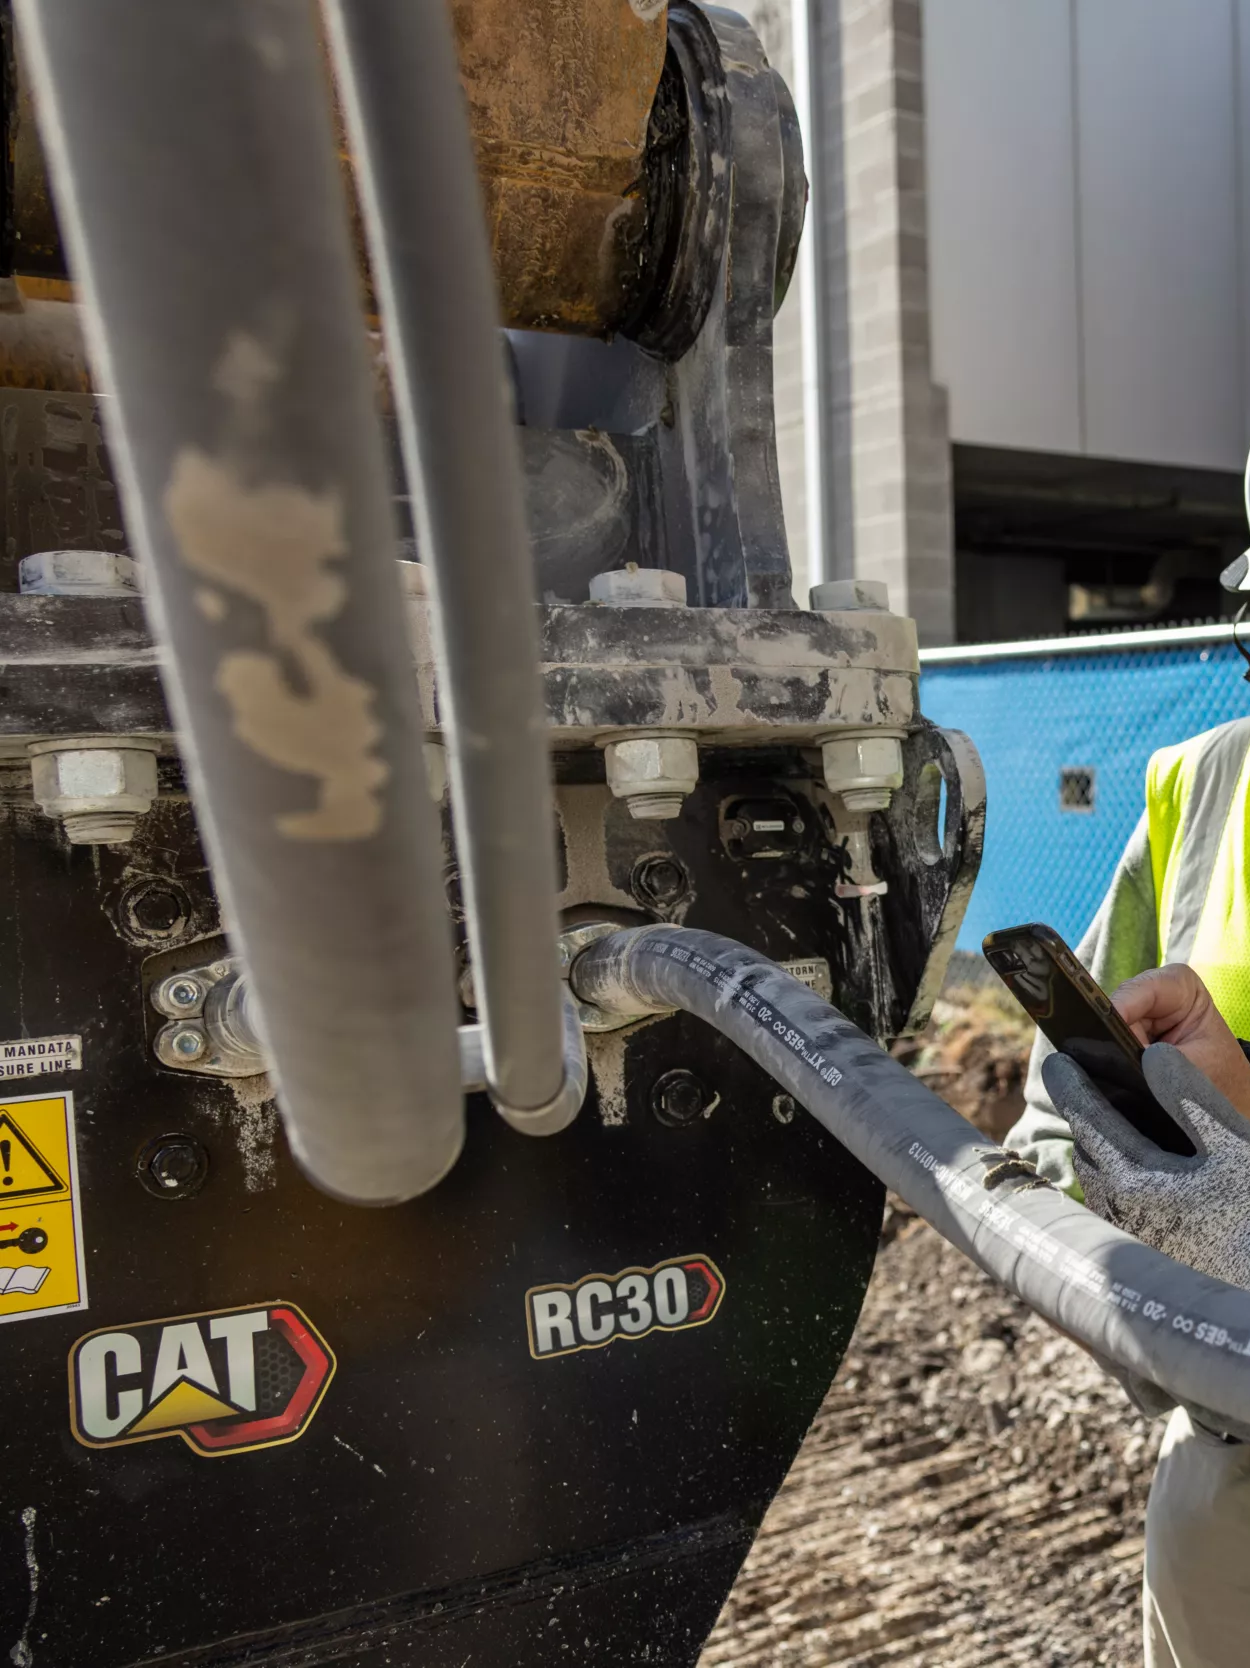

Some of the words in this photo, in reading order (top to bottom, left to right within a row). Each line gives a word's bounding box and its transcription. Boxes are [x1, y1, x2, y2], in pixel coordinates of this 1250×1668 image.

[4, 1041, 72, 1058] MANDATA
[41, 1059, 72, 1072] LINE
[533, 1266, 689, 1354] RC30
[77, 1310, 270, 1439] CAT
